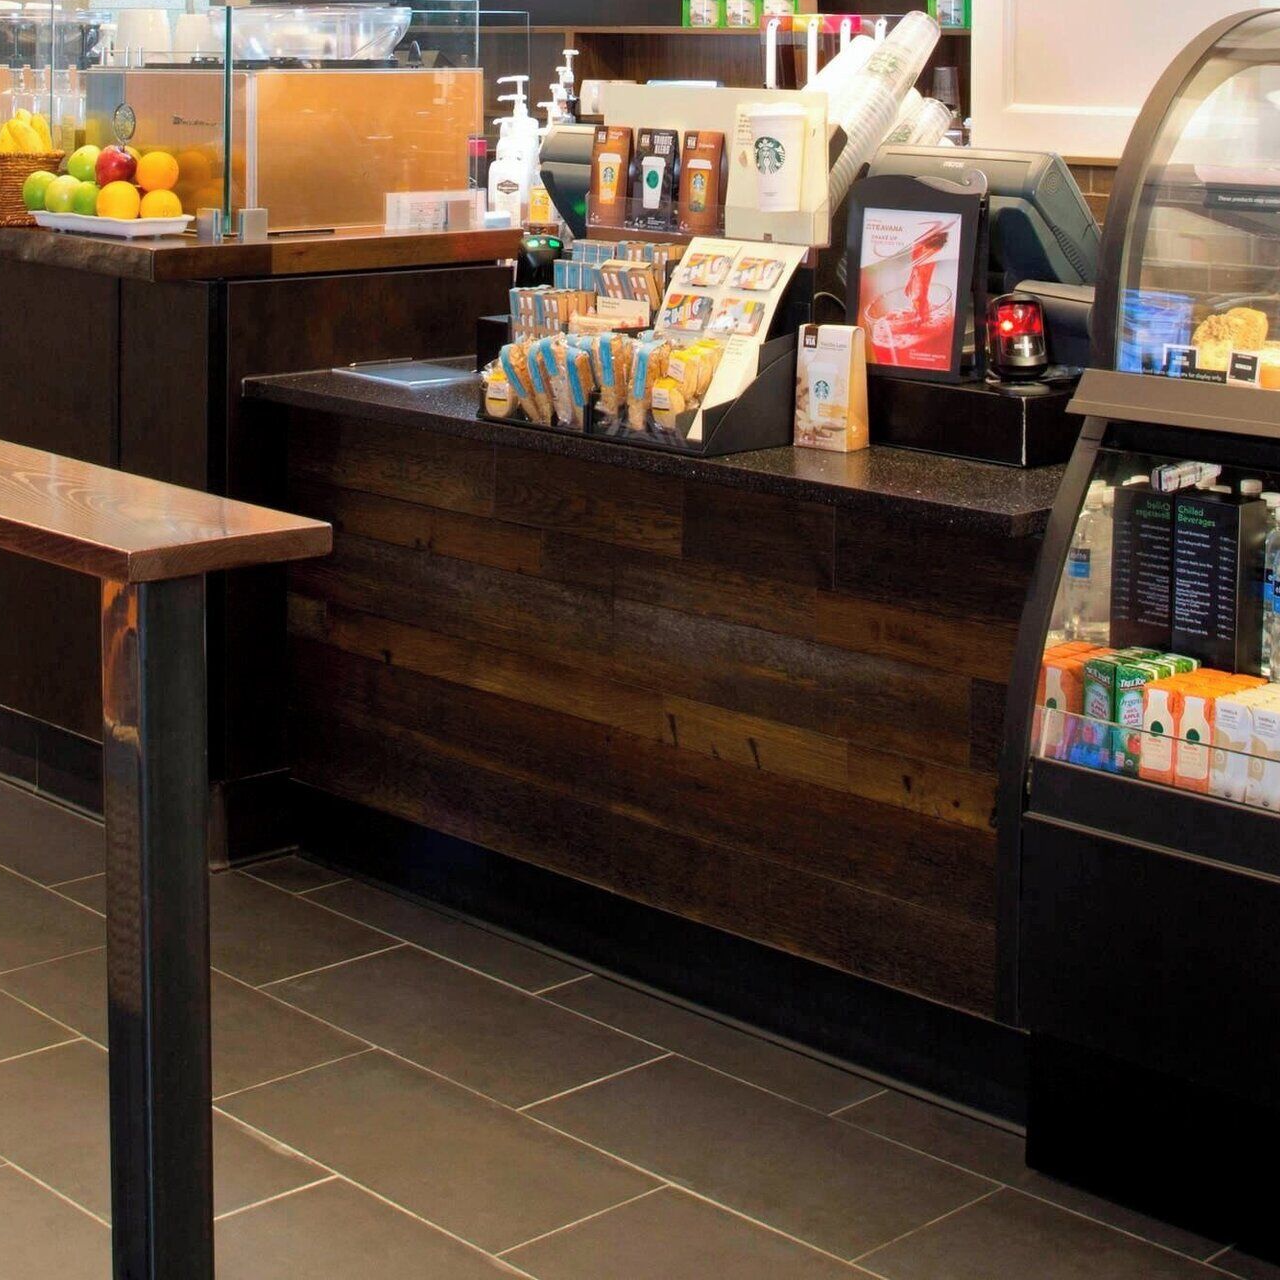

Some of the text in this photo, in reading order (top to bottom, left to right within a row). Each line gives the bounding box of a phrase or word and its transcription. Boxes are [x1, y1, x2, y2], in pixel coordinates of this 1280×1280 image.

[872, 224, 903, 232] TEAVANA
[1177, 504, 1204, 517] Chilled
[1177, 513, 1216, 528] Beverages
